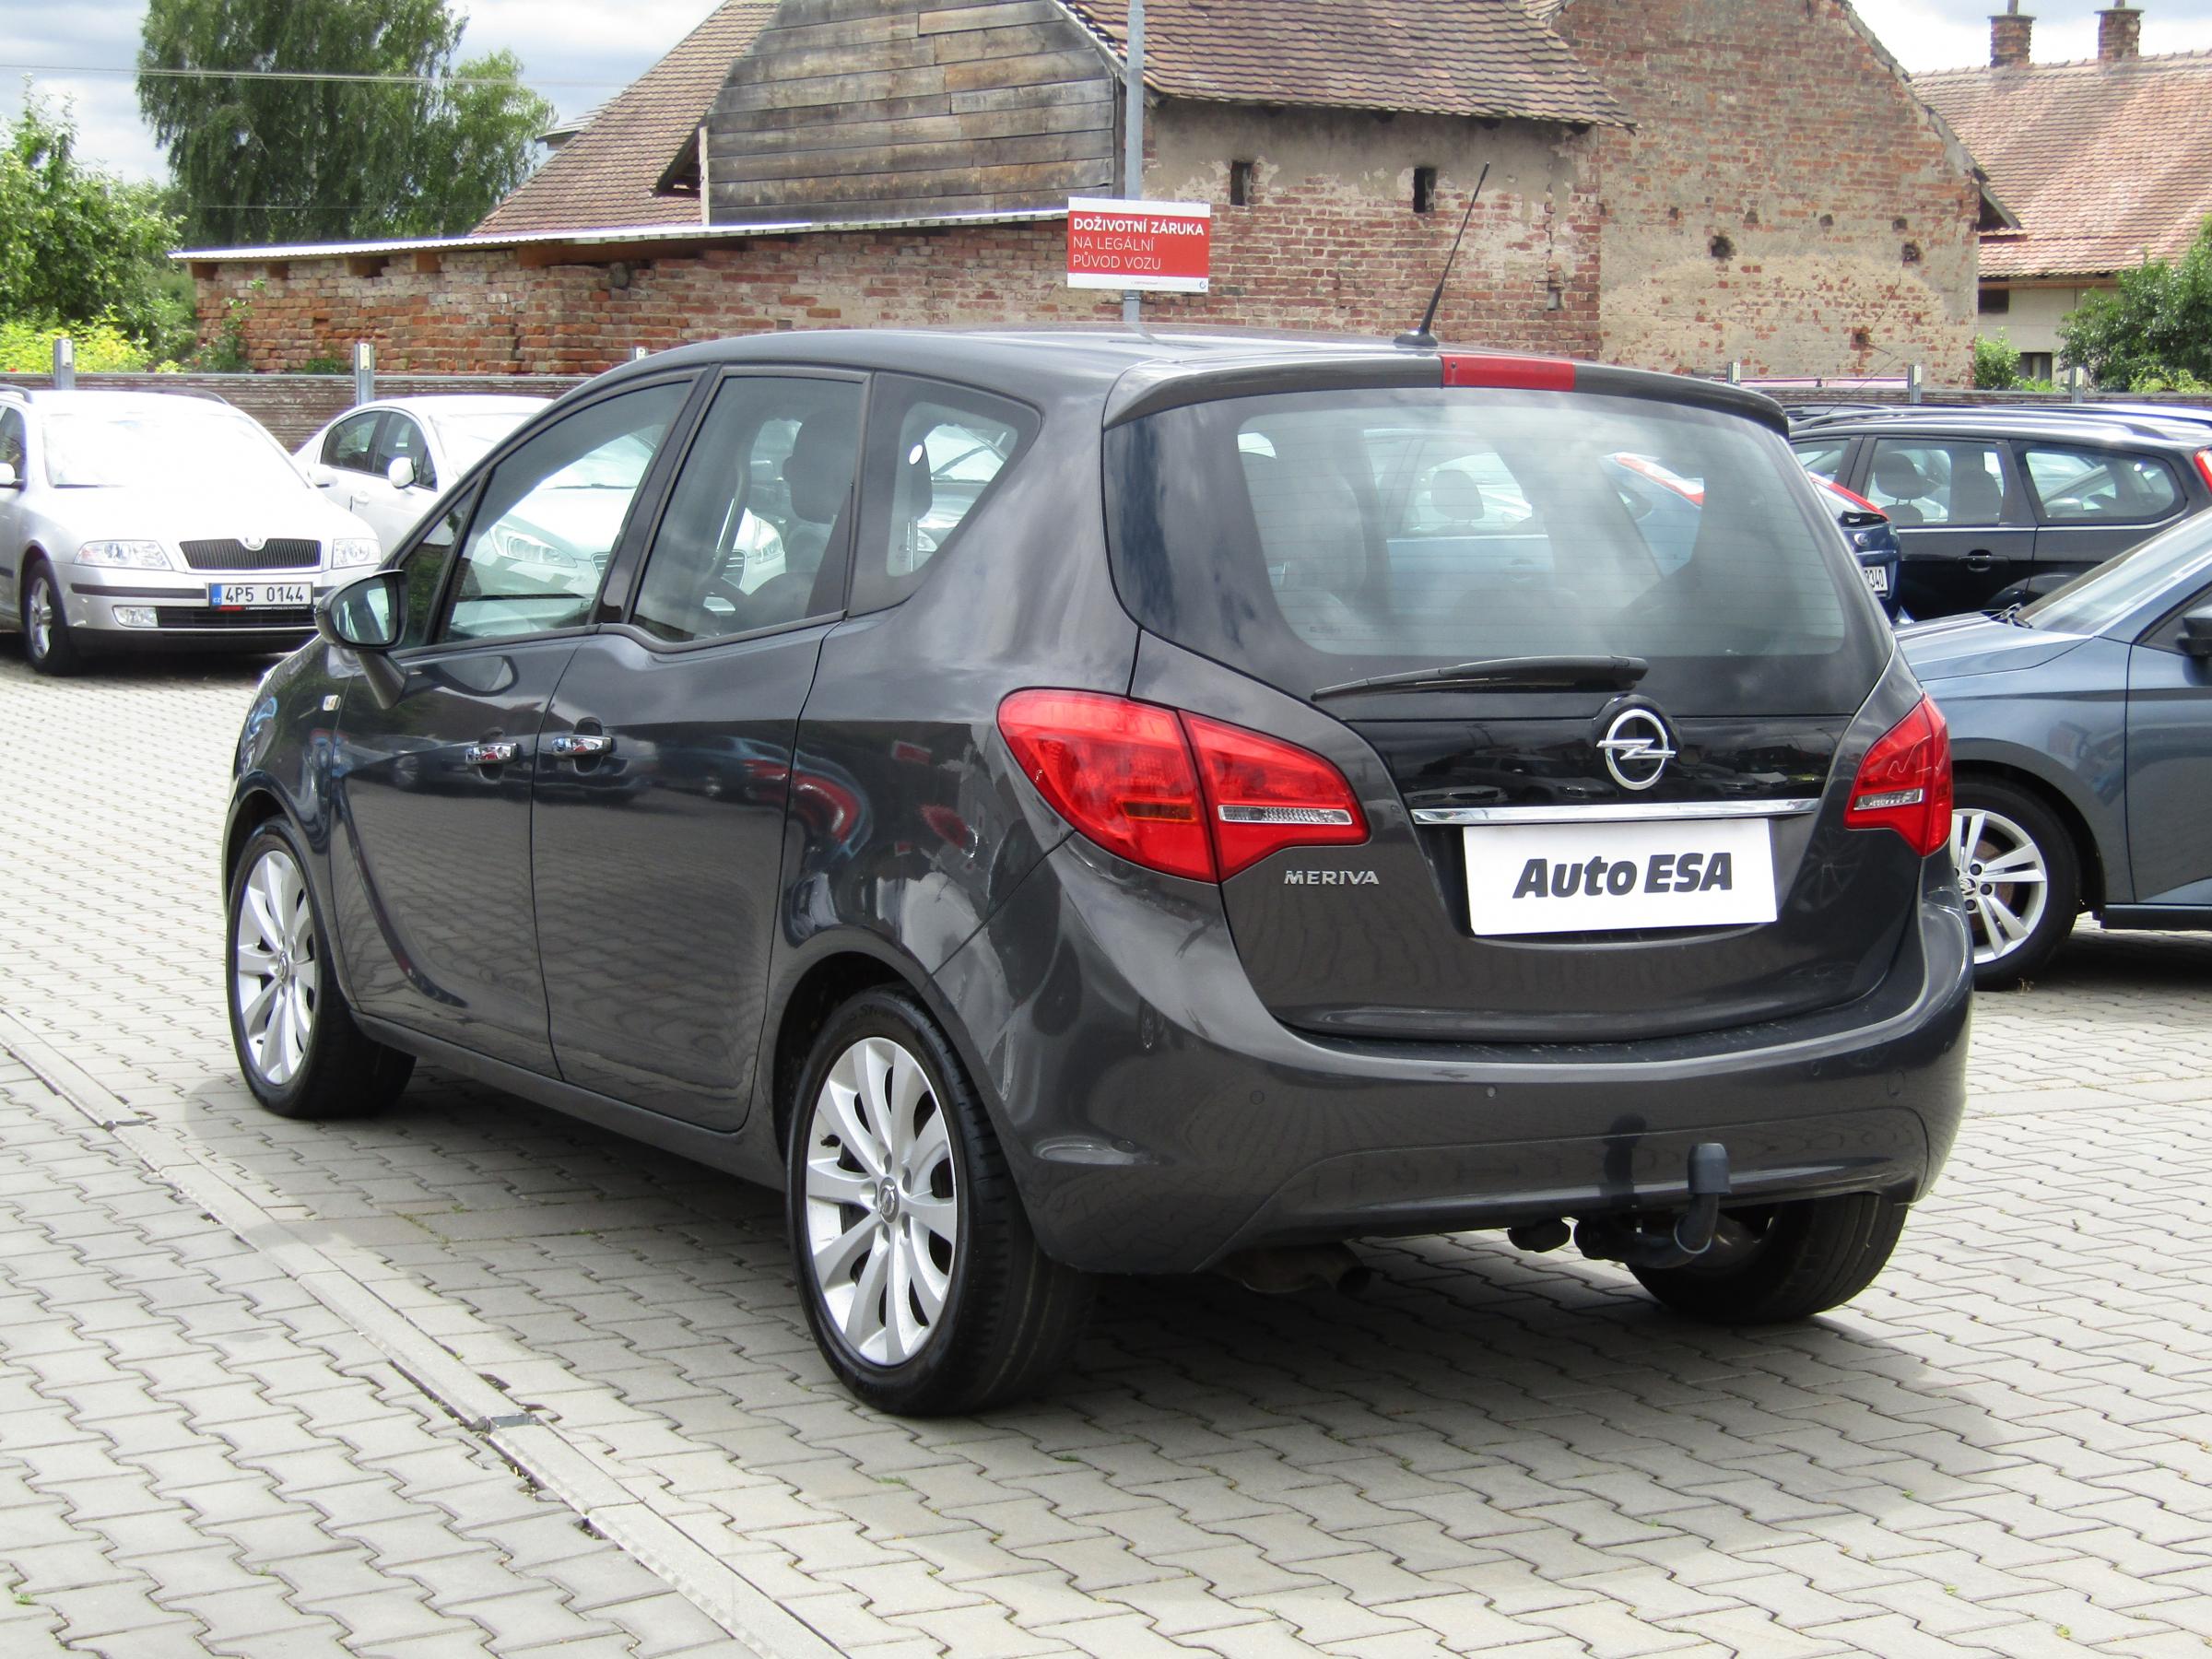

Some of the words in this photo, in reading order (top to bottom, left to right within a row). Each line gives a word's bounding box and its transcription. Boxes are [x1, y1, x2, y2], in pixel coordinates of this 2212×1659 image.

[1074, 217, 1147, 233] DOŽIVOTNÍ
[1150, 219, 1205, 236] ZÁRUKA
[1073, 236, 1093, 249] NA
[1097, 236, 1154, 252] LEGÁLNÍ
[1073, 252, 1121, 268] PŮVOD
[1124, 257, 1161, 270] VOZU
[226, 586, 254, 603] 4P5
[266, 586, 304, 603] 0144
[1284, 870, 1380, 885] MERIVA
[1512, 855, 1638, 899] Auto
[1643, 852, 1733, 894] ESA
